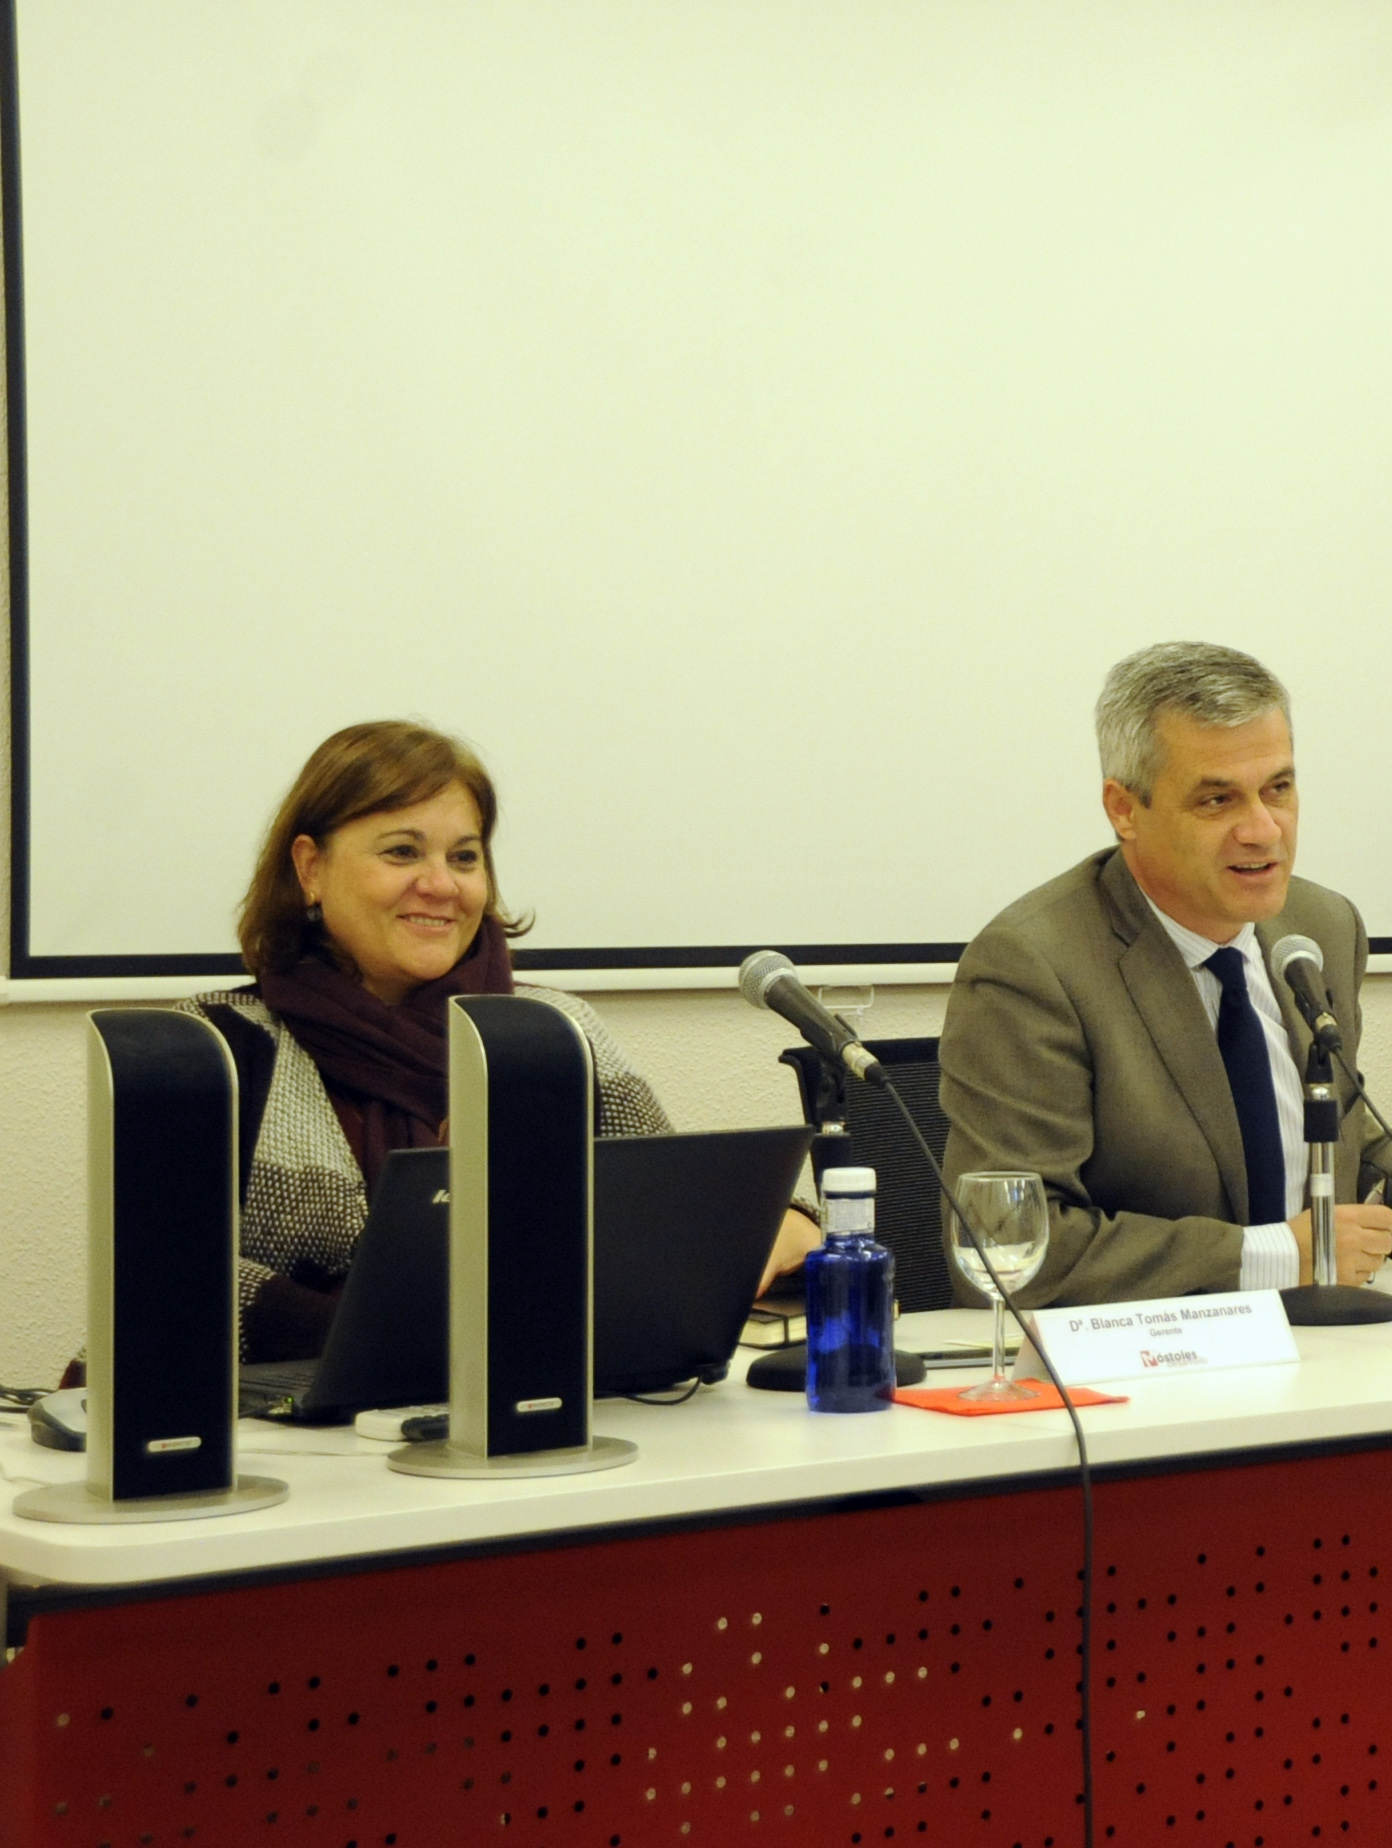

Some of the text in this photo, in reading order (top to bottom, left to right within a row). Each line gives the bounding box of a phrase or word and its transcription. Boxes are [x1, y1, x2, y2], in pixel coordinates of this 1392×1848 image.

[1090, 1316, 1134, 1330] Blanca
[1136, 1311, 1178, 1325] Tomás
[1180, 1304, 1253, 1321] Manzanares
[1150, 1327, 1183, 1337] Gerente
